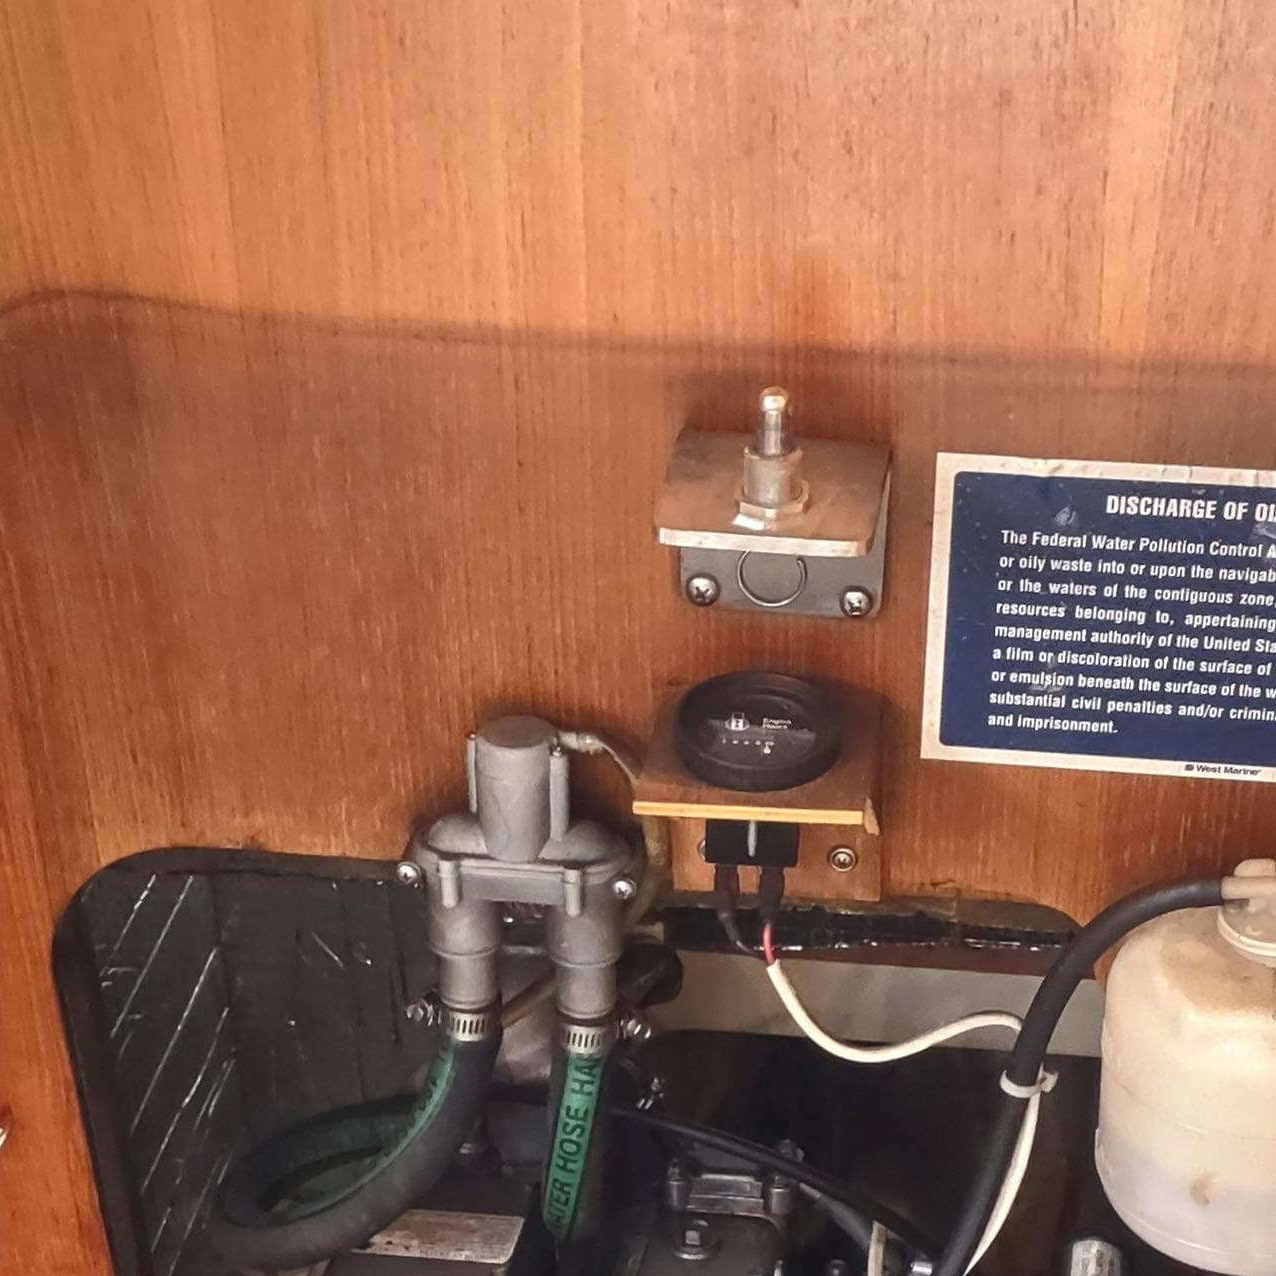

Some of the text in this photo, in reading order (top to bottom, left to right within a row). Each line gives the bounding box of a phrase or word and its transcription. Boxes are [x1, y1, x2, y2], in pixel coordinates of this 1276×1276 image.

[1105, 494, 1217, 520] DISCHARGE
[1222, 500, 1249, 522] OF
[1001, 529, 1028, 545] The
[1031, 531, 1087, 548] Federal
[1091, 534, 1136, 551] Water
[1138, 536, 1205, 555] Pollution
[1208, 540, 1263, 558] Control
[998, 556, 1015, 568] or
[1018, 554, 1046, 572] oily
[1049, 556, 1093, 572] waste
[1097, 558, 1126, 574] into
[1129, 563, 1146, 575] or
[1149, 564, 1186, 580] upon
[1189, 563, 1214, 579] the
[997, 579, 1013, 591] or
[1018, 577, 1042, 593] the
[1047, 579, 1097, 596] waters
[1102, 582, 1118, 597] of
[1123, 583, 1148, 599] the
[1153, 585, 1234, 606] contiguous
[995, 602, 1066, 618] resources
[1074, 604, 1146, 625] belonging
[1154, 609, 1175, 624] to,
[1183, 610, 1276, 632] appertaining
[994, 622, 1087, 644] management
[1089, 628, 1155, 648] authority
[1157, 632, 1172, 647] of
[1175, 633, 1199, 648] the
[1202, 634, 1251, 651] United
[992, 648, 1002, 659] a
[1005, 646, 1034, 661] film
[1038, 650, 1055, 662] or
[1057, 649, 1150, 668] discoloration
[1153, 655, 1169, 669] of
[1171, 656, 1195, 671] the
[1198, 657, 1253, 674] surface
[1256, 661, 1272, 676] of
[990, 670, 1006, 682] or
[1009, 668, 1074, 686] emulsion
[1077, 673, 1135, 690] beneath
[1138, 676, 1161, 691] the
[1163, 678, 1217, 695] surface
[1220, 681, 1236, 696] of
[1237, 682, 1262, 698] the
[988, 689, 1066, 708] substantial
[1071, 694, 1102, 710] civil
[1106, 697, 1173, 717] penalties
[1177, 701, 1225, 718] and/or
[987, 712, 1119, 736] and imprisonment.
[1196, 764, 1221, 774] West
[555, 1104, 590, 1174] HOSE
